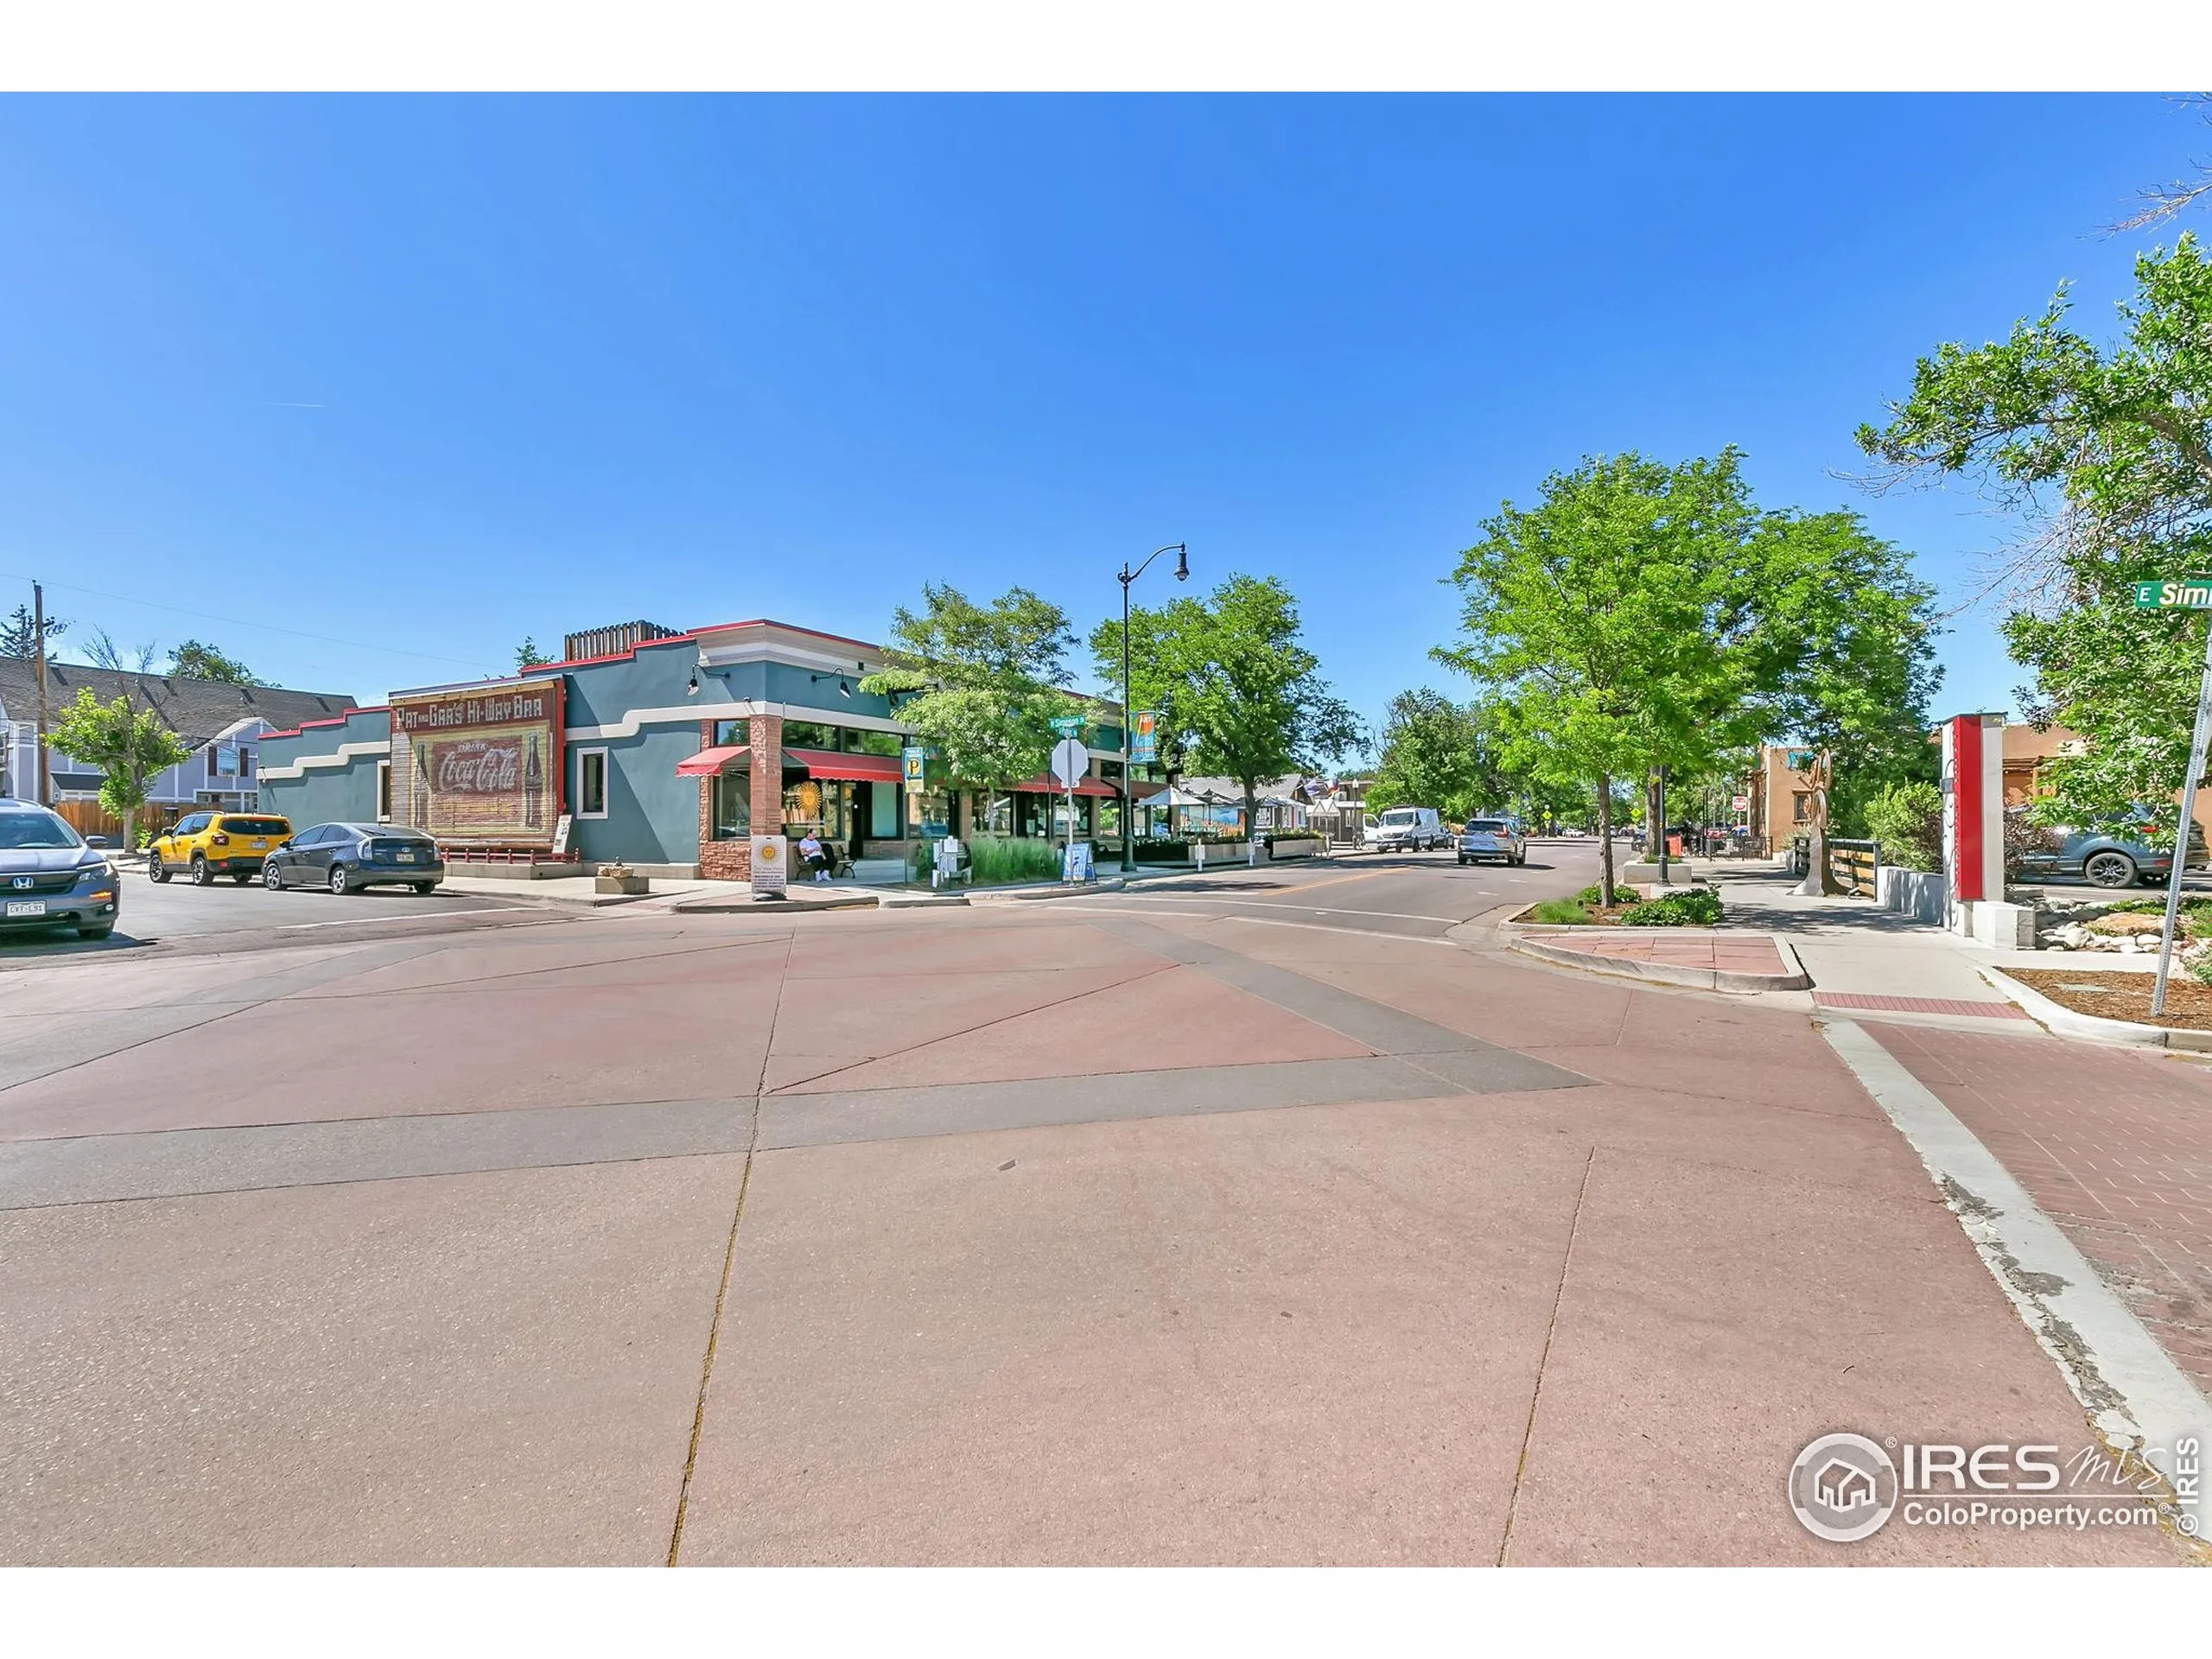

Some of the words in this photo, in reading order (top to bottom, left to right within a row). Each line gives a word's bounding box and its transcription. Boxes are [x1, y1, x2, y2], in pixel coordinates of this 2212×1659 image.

[2139, 587, 2152, 602] E
[396, 707, 418, 729] PAT
[513, 695, 543, 719] BAR
